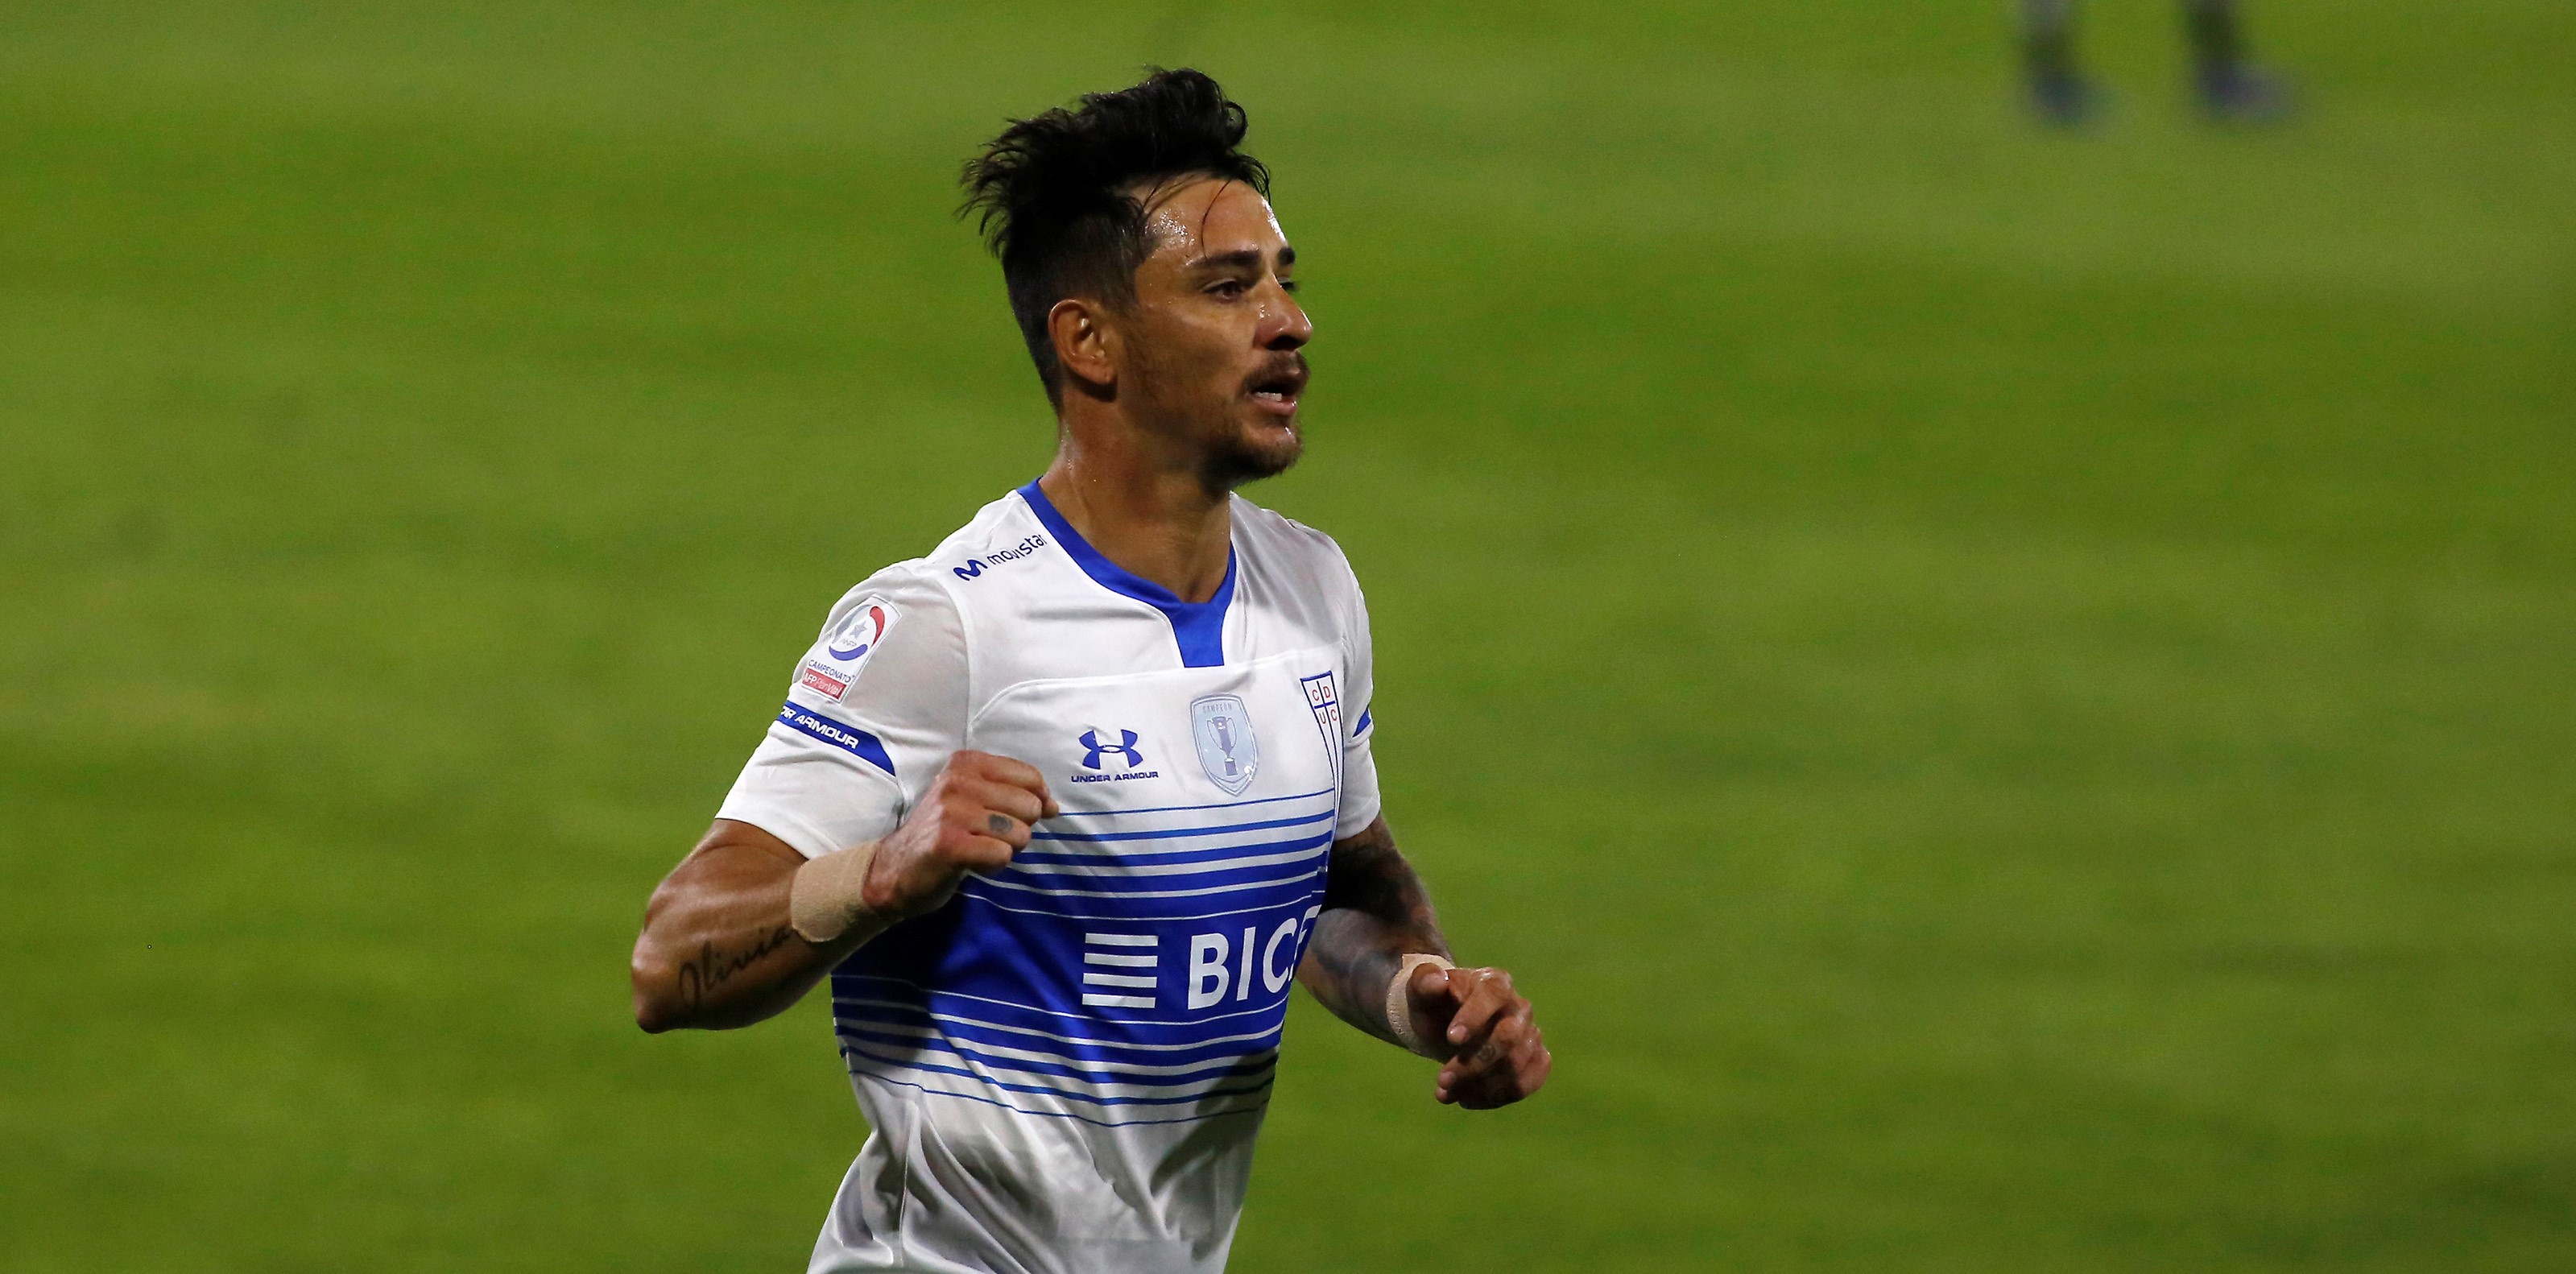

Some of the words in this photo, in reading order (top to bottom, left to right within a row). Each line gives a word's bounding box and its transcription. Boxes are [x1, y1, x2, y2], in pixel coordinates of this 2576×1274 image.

[808, 660, 851, 683] CAMPEONATO
[794, 714, 859, 749] ARMOUR
[1071, 775, 1110, 783] UNDER
[1114, 771, 1159, 781] ARMOUR
